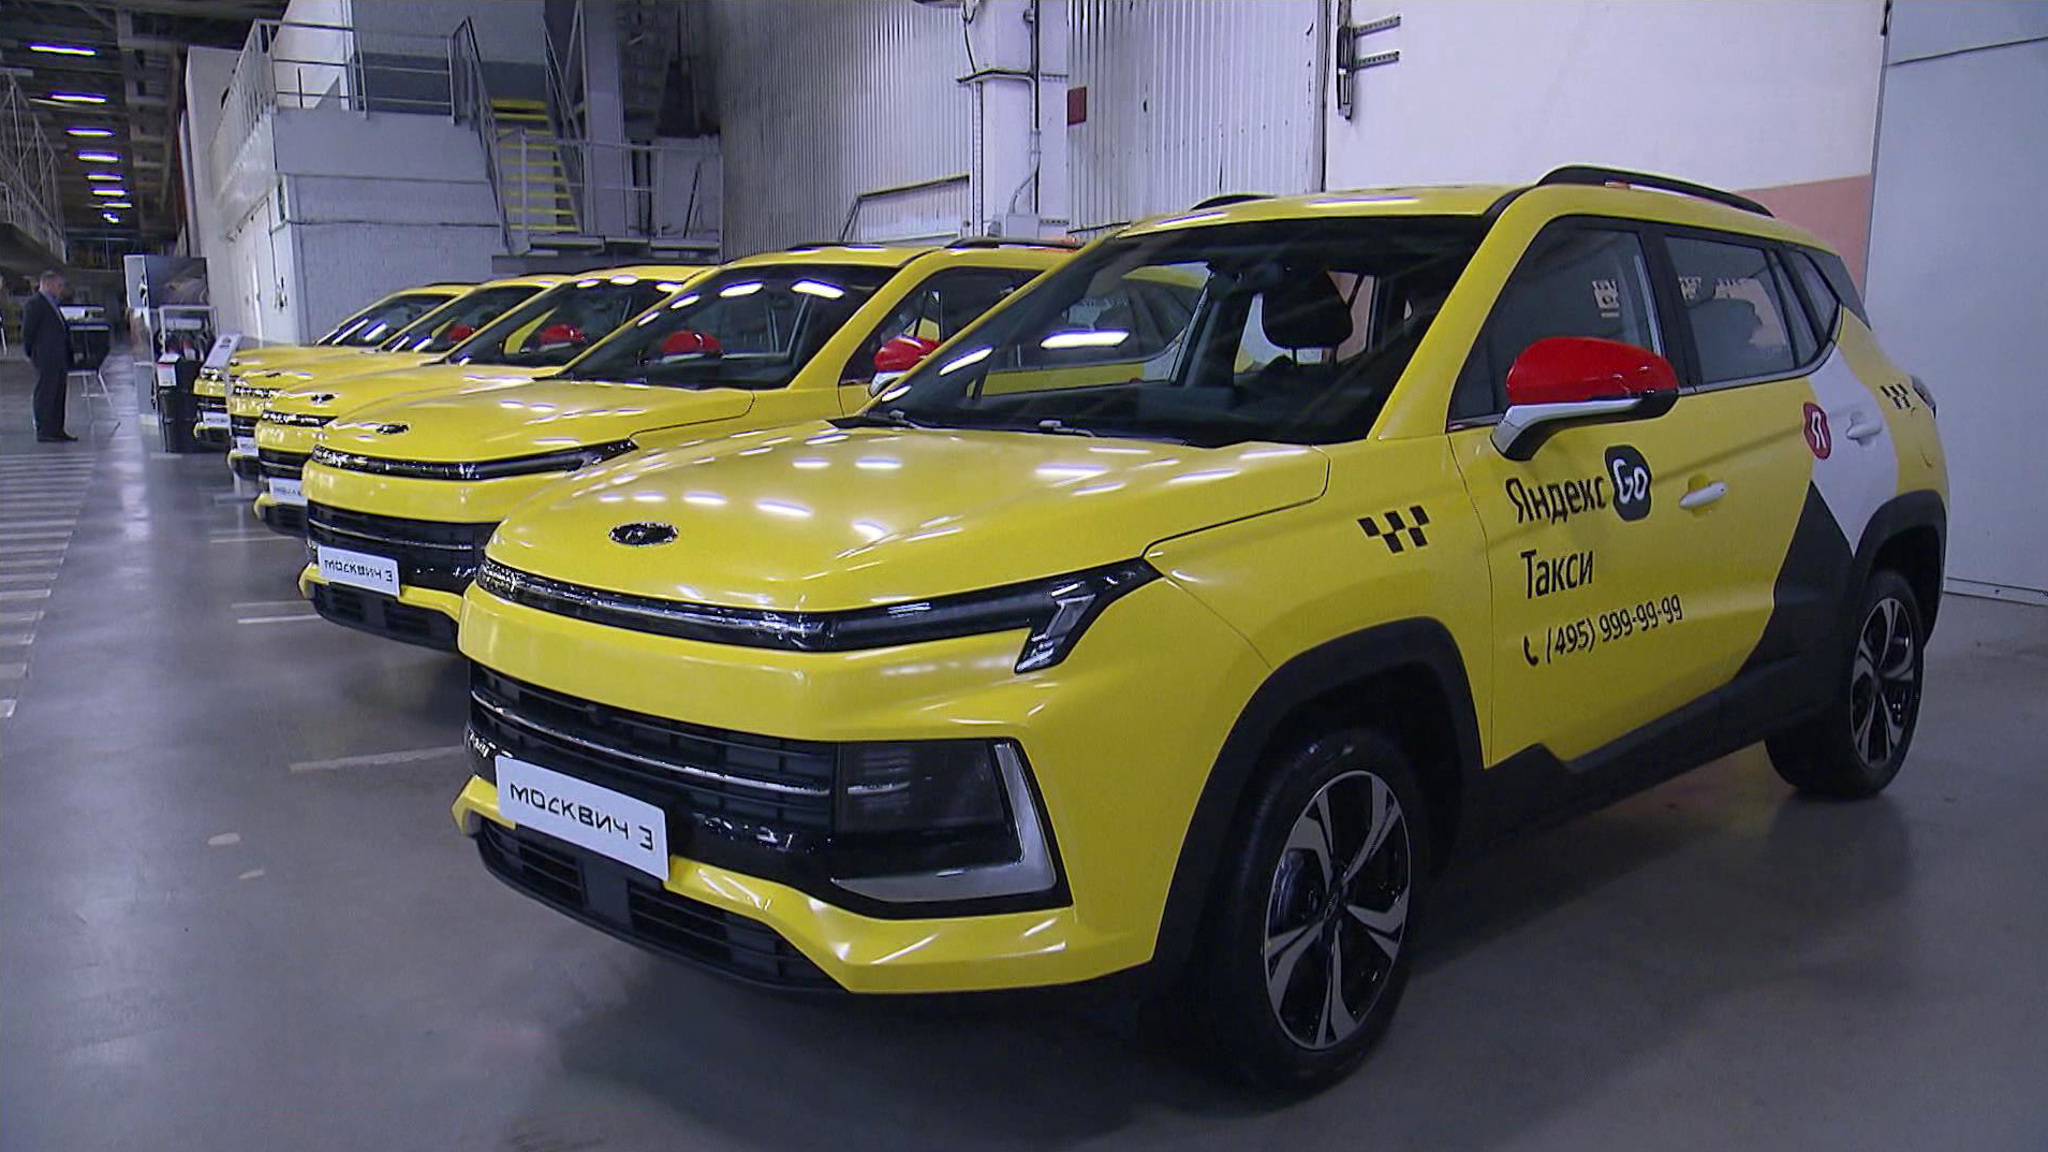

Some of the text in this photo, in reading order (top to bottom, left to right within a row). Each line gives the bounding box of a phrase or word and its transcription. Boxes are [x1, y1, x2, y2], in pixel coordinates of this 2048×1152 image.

[1505, 458, 1649, 524] Яндекс Go
[323, 559, 394, 583] МОСКВИЧ 3
[1520, 549, 1593, 600] Такси
[1545, 593, 1684, 665] (495) 999-99-99
[509, 781, 654, 851] МОСКВИЧ 3
